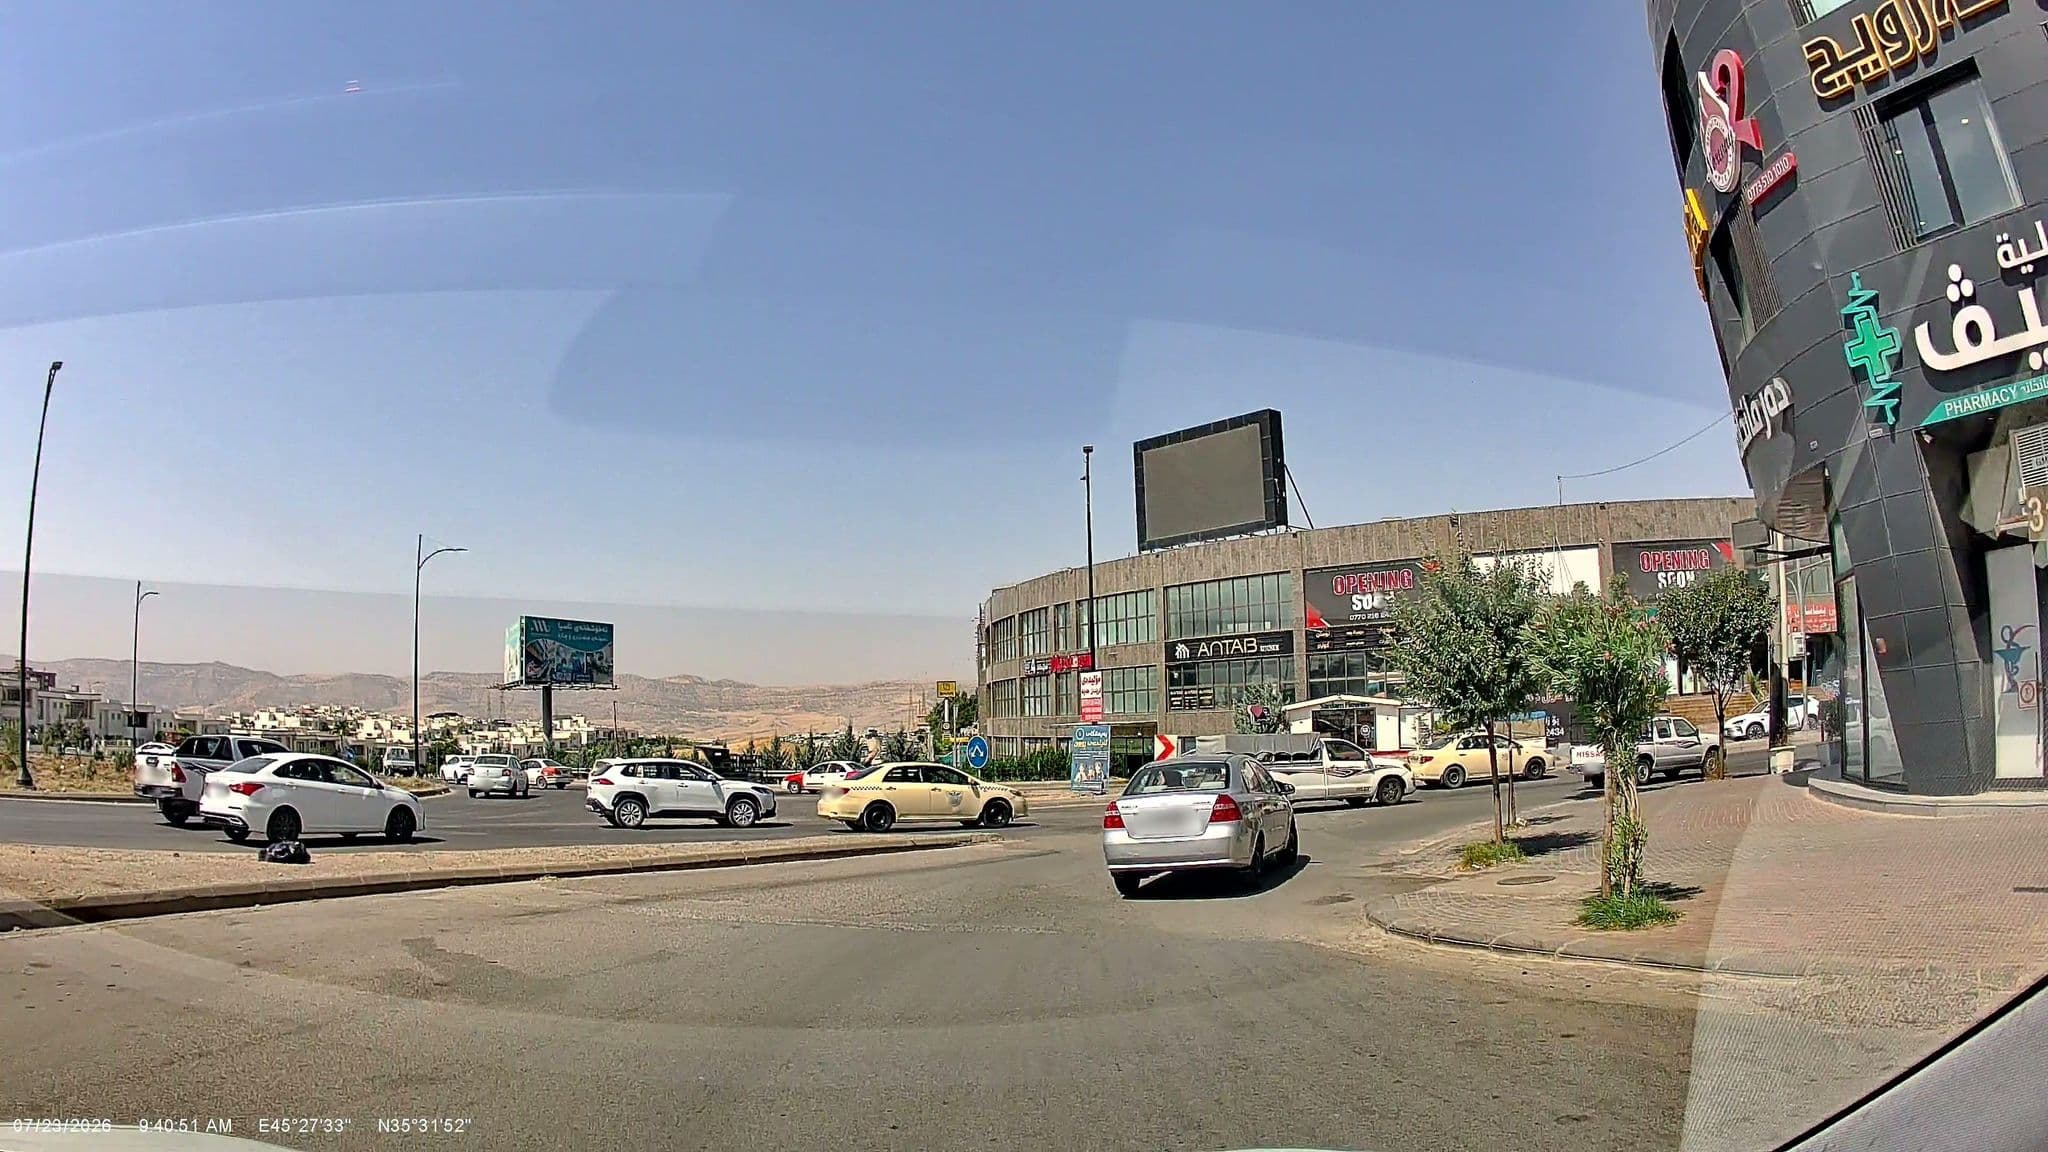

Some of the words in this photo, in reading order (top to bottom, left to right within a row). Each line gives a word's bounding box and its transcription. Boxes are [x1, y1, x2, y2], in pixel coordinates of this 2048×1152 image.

[1944, 383, 2018, 417] PHARMACY
[1639, 548, 1711, 573] OPENING
[1332, 568, 1414, 596] OPENING
[1197, 637, 1258, 657] ANTAB
[1576, 750, 1604, 759] NISSA
